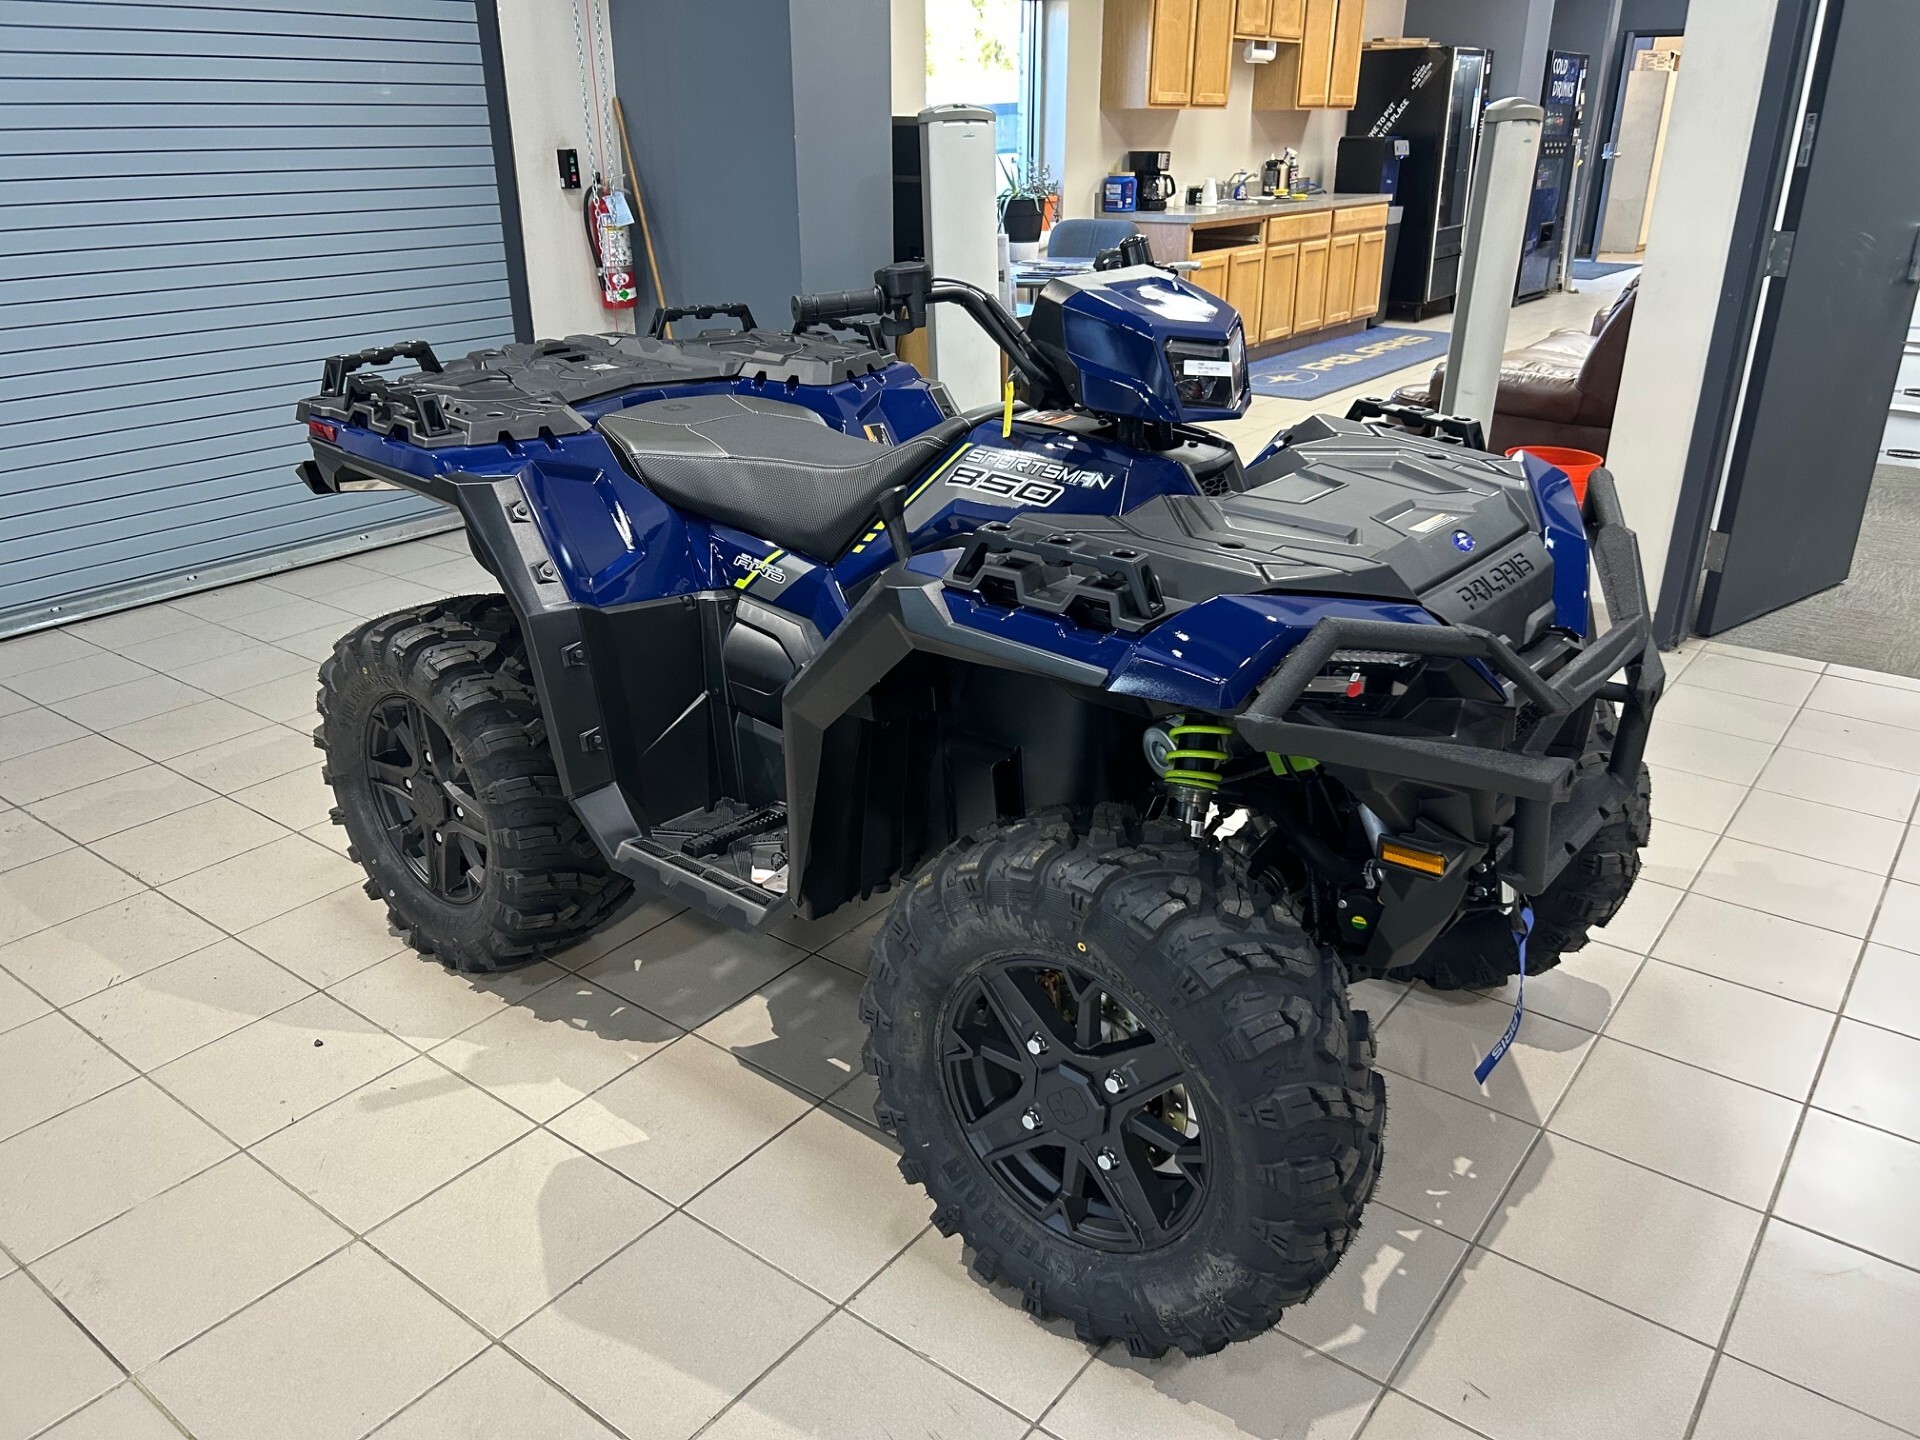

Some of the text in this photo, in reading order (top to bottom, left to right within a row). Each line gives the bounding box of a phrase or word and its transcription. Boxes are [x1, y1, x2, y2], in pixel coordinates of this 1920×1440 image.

[1553, 57, 1569, 75] COLD
[1552, 80, 1575, 98] DRINKS
[1376, 116, 1386, 126] TO
[1383, 101, 1397, 118] PUT
[1381, 121, 1393, 134] ITS
[1389, 98, 1410, 123] PLACE
[1296, 333, 1434, 372] POLARIS
[944, 463, 1065, 508] 850
[964, 449, 1117, 490] SPORTSMAN
[732, 555, 787, 585] AWD
[1456, 551, 1536, 611] POLARIS
